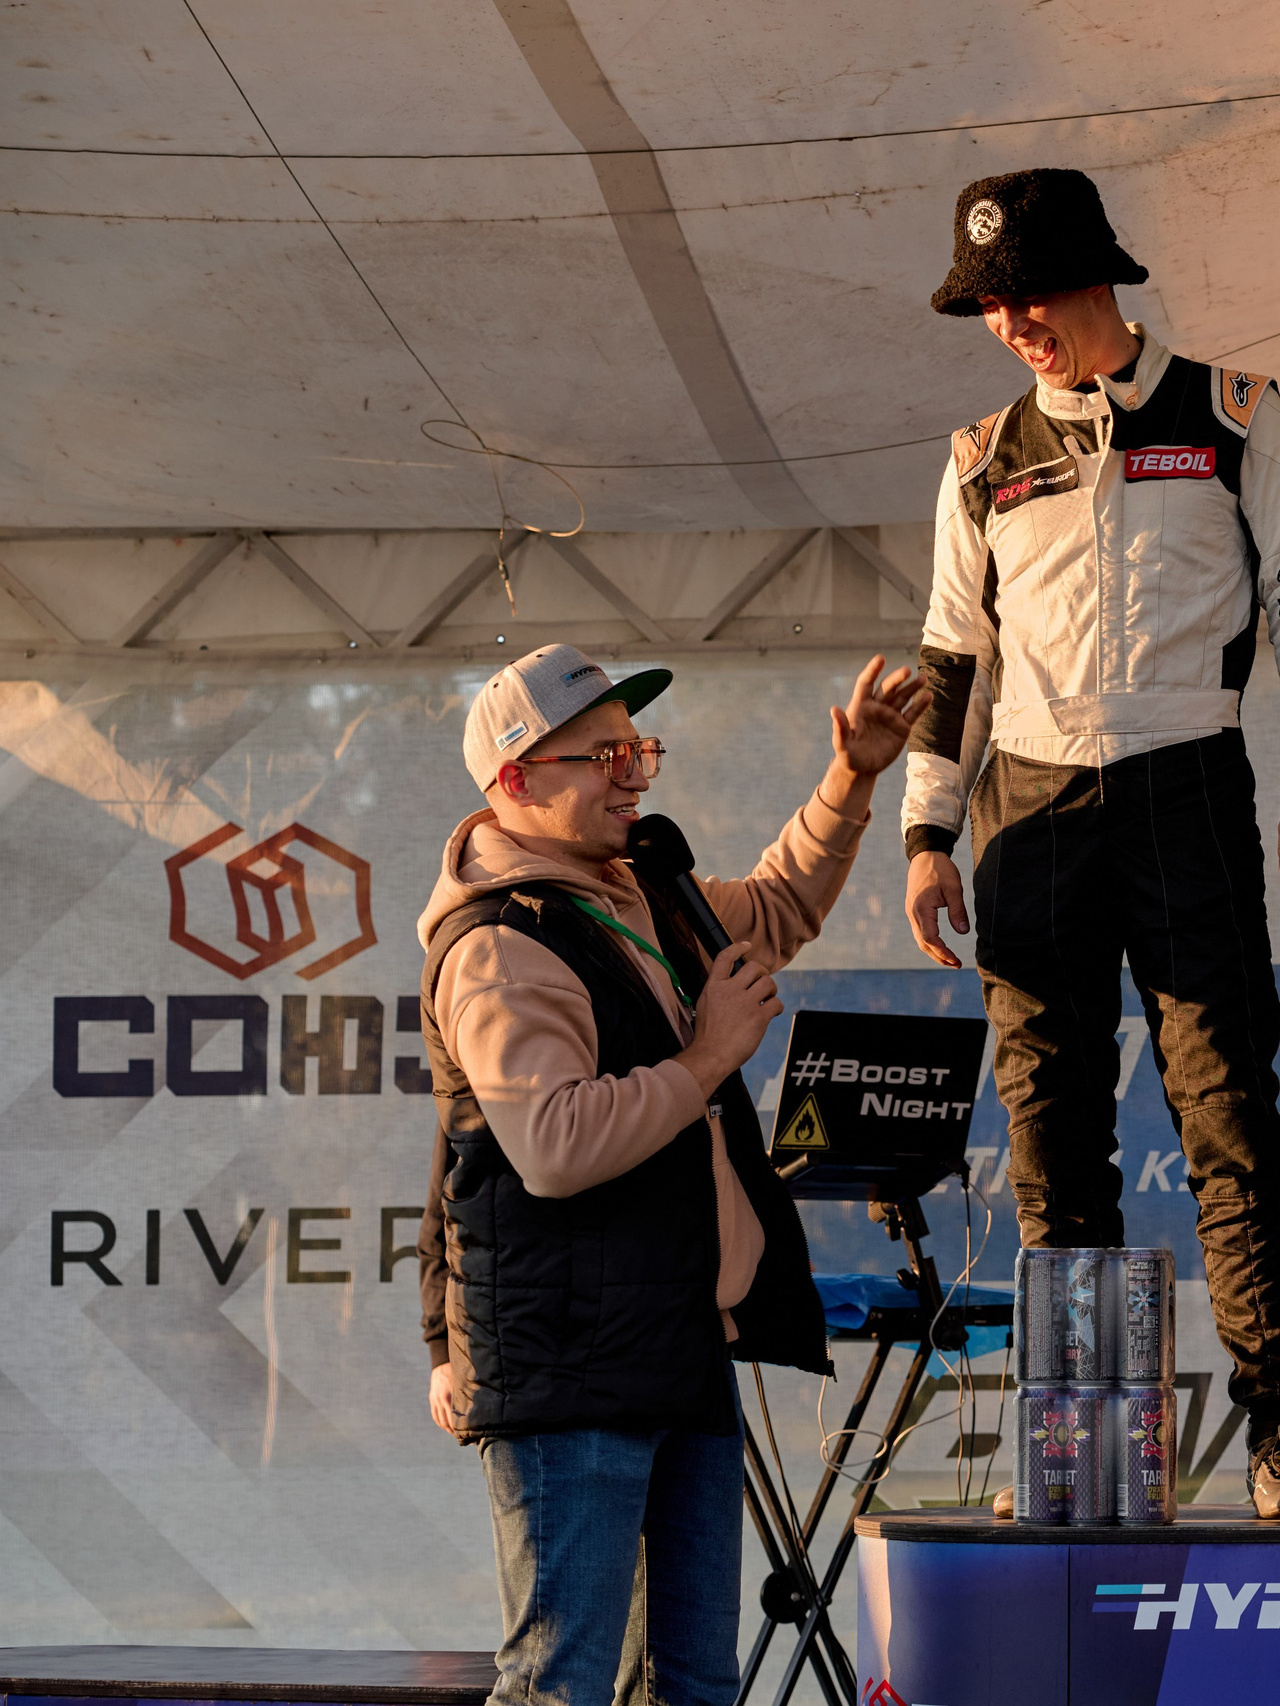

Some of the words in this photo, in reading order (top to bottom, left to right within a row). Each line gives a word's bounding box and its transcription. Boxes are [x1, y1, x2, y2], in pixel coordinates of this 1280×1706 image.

[1130, 453, 1210, 472] TEBOIL
[996, 477, 1033, 503] RDS
[1043, 1469, 1077, 1486] TARET
